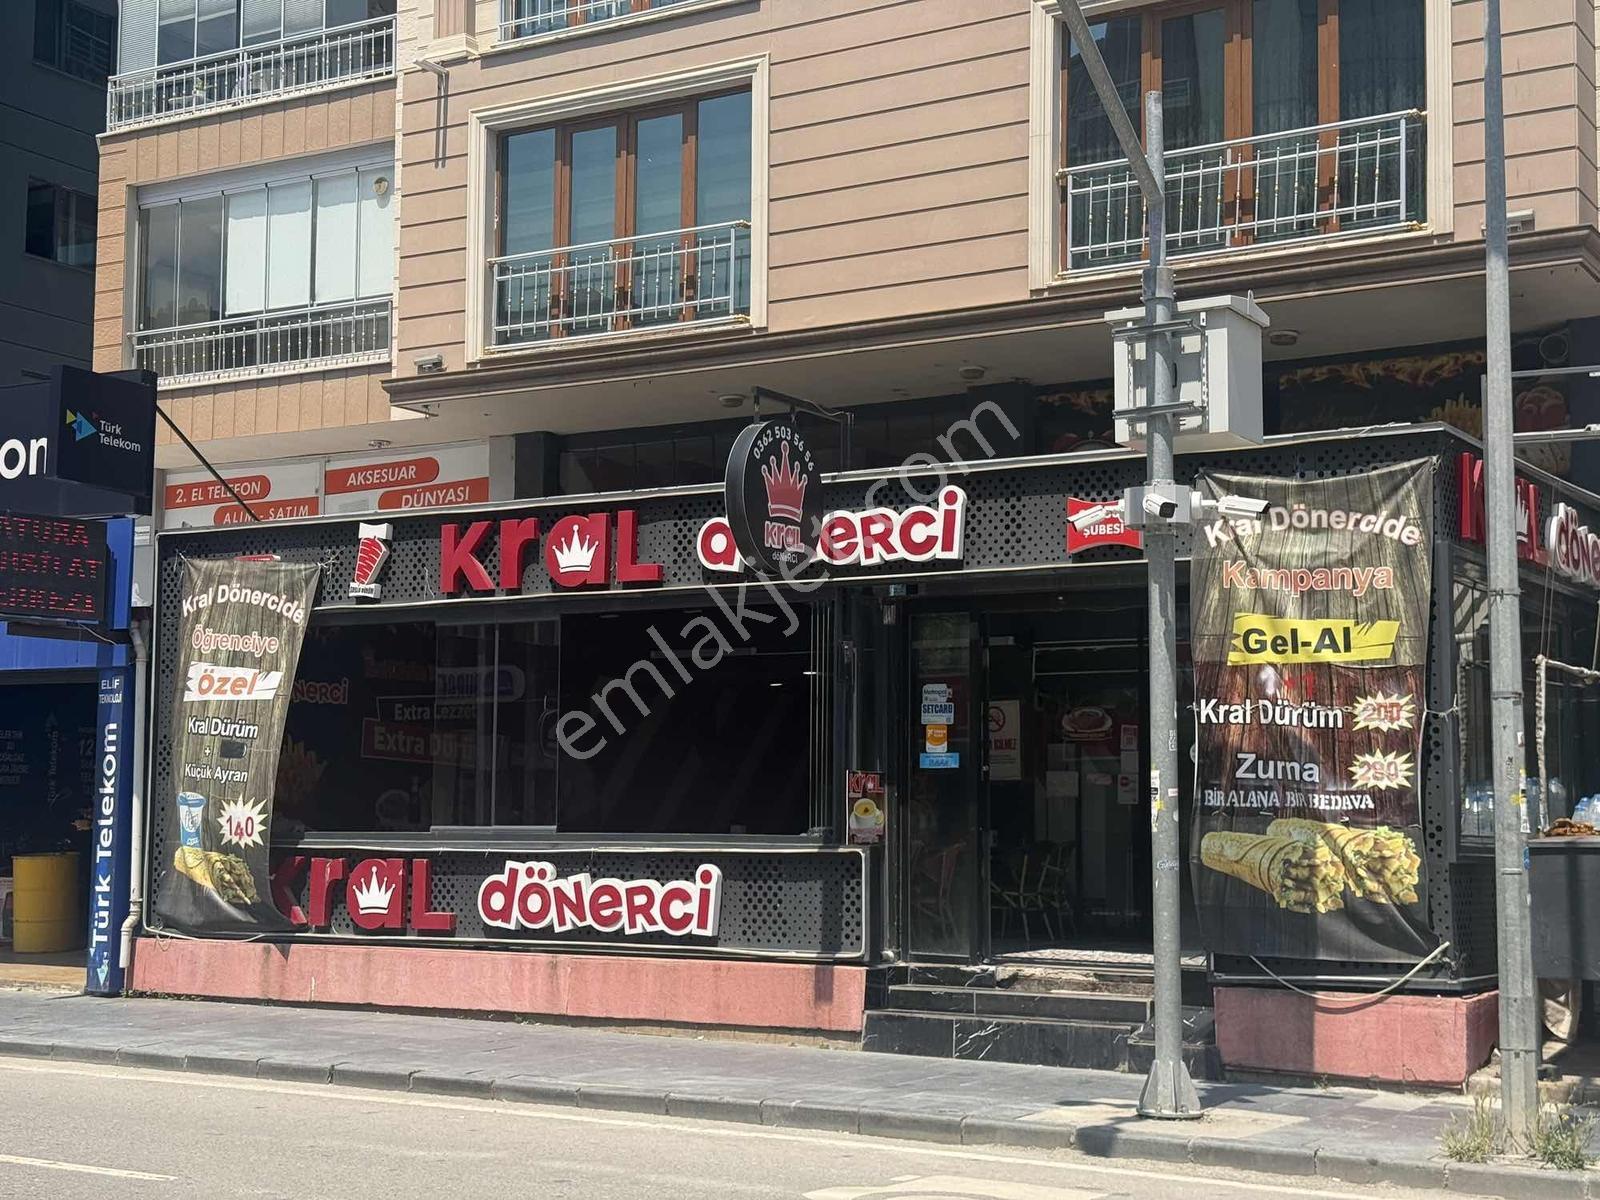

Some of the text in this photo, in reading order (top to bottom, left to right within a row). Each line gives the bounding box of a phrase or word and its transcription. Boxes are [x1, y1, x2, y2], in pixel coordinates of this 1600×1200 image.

[100, 420, 122, 435] Türk
[99, 433, 141, 452] Telekom
[753, 426, 814, 471] 0362 503 56 56
[346, 465, 417, 487] AKSESUAR
[176, 481, 261, 504] 2. EL TELEFON
[401, 486, 470, 509] DÜNYASI
[269, 505, 309, 520] SATIM
[1269, 503, 1421, 546] Dönercide
[1083, 523, 1124, 539] ŞUBESİ
[1223, 560, 1393, 597] Kampanya
[182, 583, 304, 624] Kral Dönercide
[192, 623, 279, 658] Öğrenciye
[1242, 627, 1352, 655] Gel-Al
[198, 668, 259, 696] Özel
[922, 703, 953, 716] SETCARD
[1199, 698, 1345, 729] Kral Dürüm
[188, 716, 259, 739] Kral Dürüm
[373, 725, 425, 757] Extra
[184, 763, 248, 784] Küçük Ayran
[96, 722, 117, 863] Telekom
[1204, 788, 1225, 807] BİR
[1226, 789, 1280, 808] ALANA
[226, 815, 255, 841] 140
[93, 873, 110, 950] Türk
